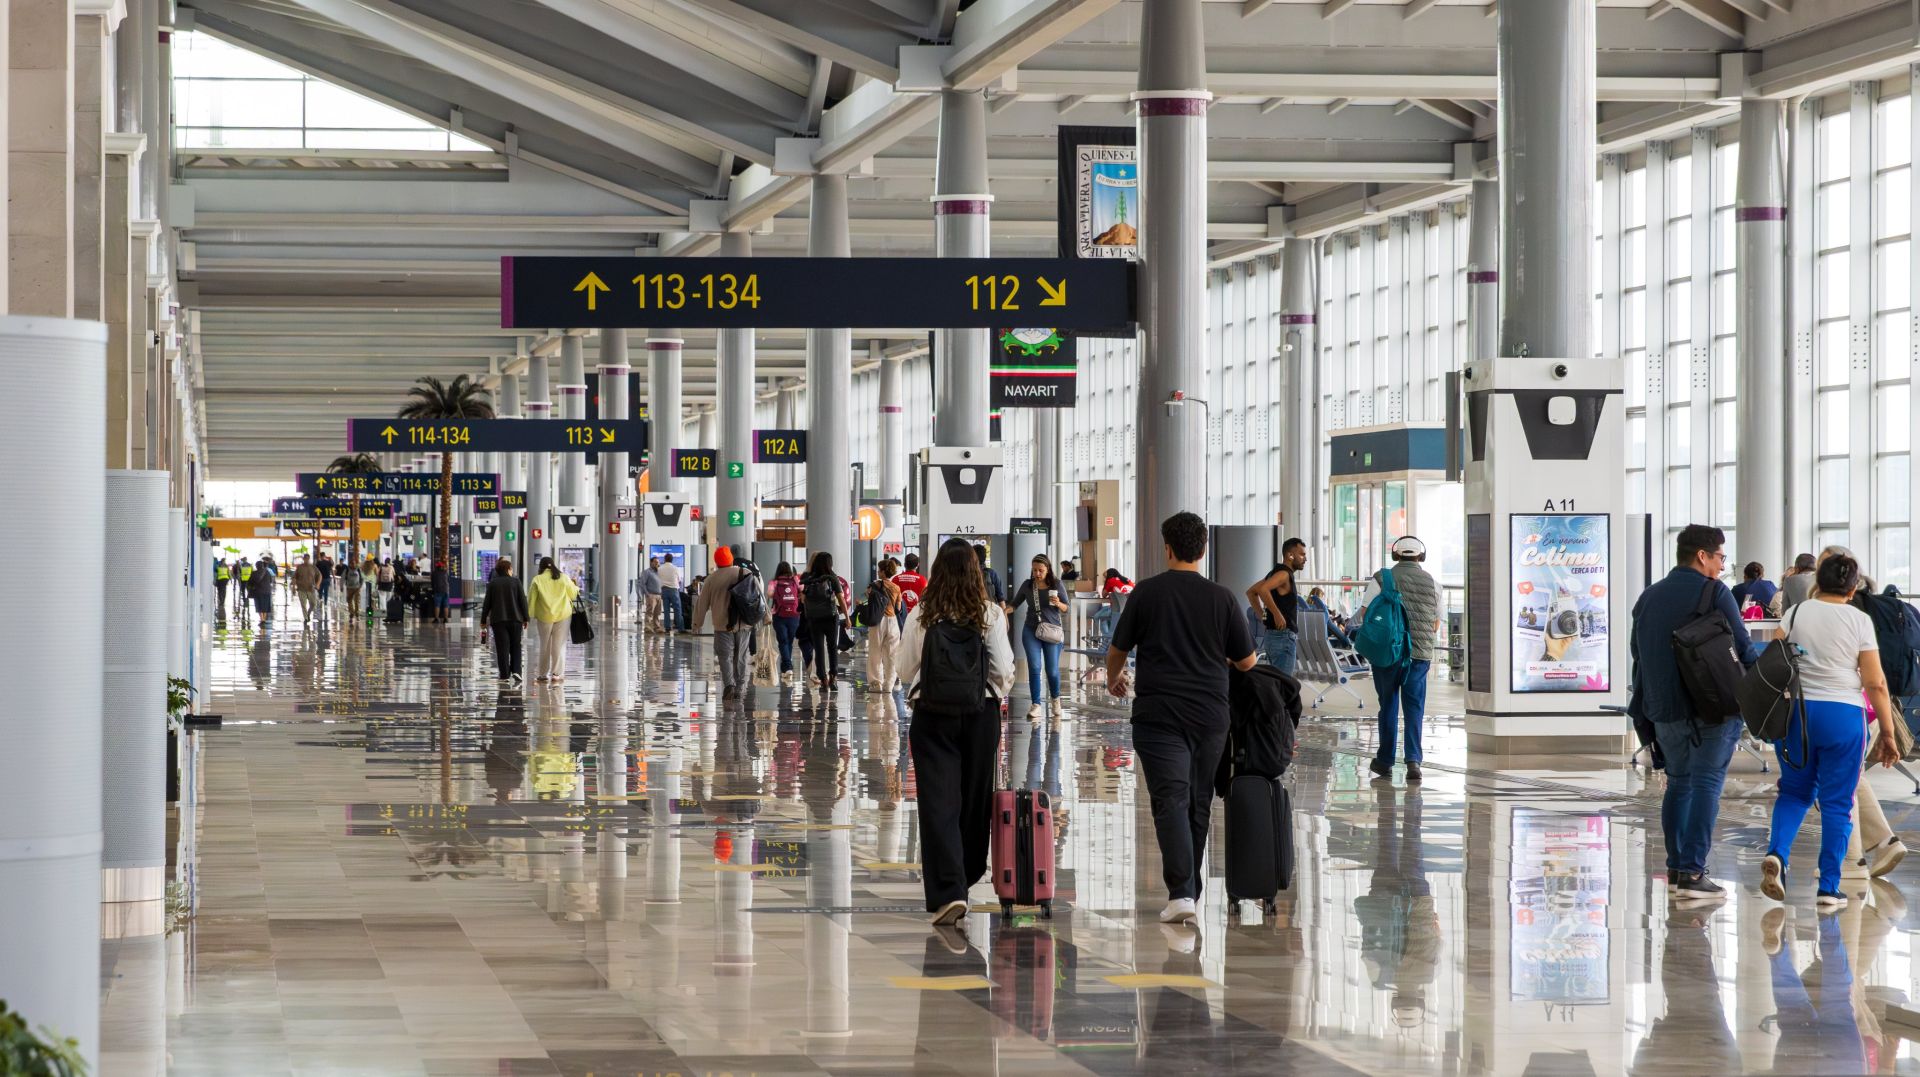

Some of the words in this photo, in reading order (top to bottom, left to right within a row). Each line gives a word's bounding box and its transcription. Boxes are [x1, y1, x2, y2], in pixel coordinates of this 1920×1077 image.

[632, 273, 761, 309] 113-134
[965, 275, 1020, 310] 112
[1004, 385, 1058, 397] NAYARIT
[408, 426, 471, 444] 114-134
[565, 426, 593, 445] 113
[763, 438, 785, 455] 112
[788, 438, 799, 455] A
[680, 456, 698, 471] 112
[702, 456, 711, 471] B
[331, 477, 367, 489] 115-13
[402, 478, 442, 490] 114-13
[460, 479, 479, 490] 113
[478, 501, 489, 509] 113
[490, 501, 496, 509] B
[503, 495, 515, 505] 113
[516, 495, 523, 505] A
[1544, 498, 1555, 511] A
[1560, 498, 1575, 511] 11
[364, 507, 375, 516] 114
[956, 525, 962, 533] A
[965, 525, 975, 533] 12
[1521, 545, 1600, 566] Colima
